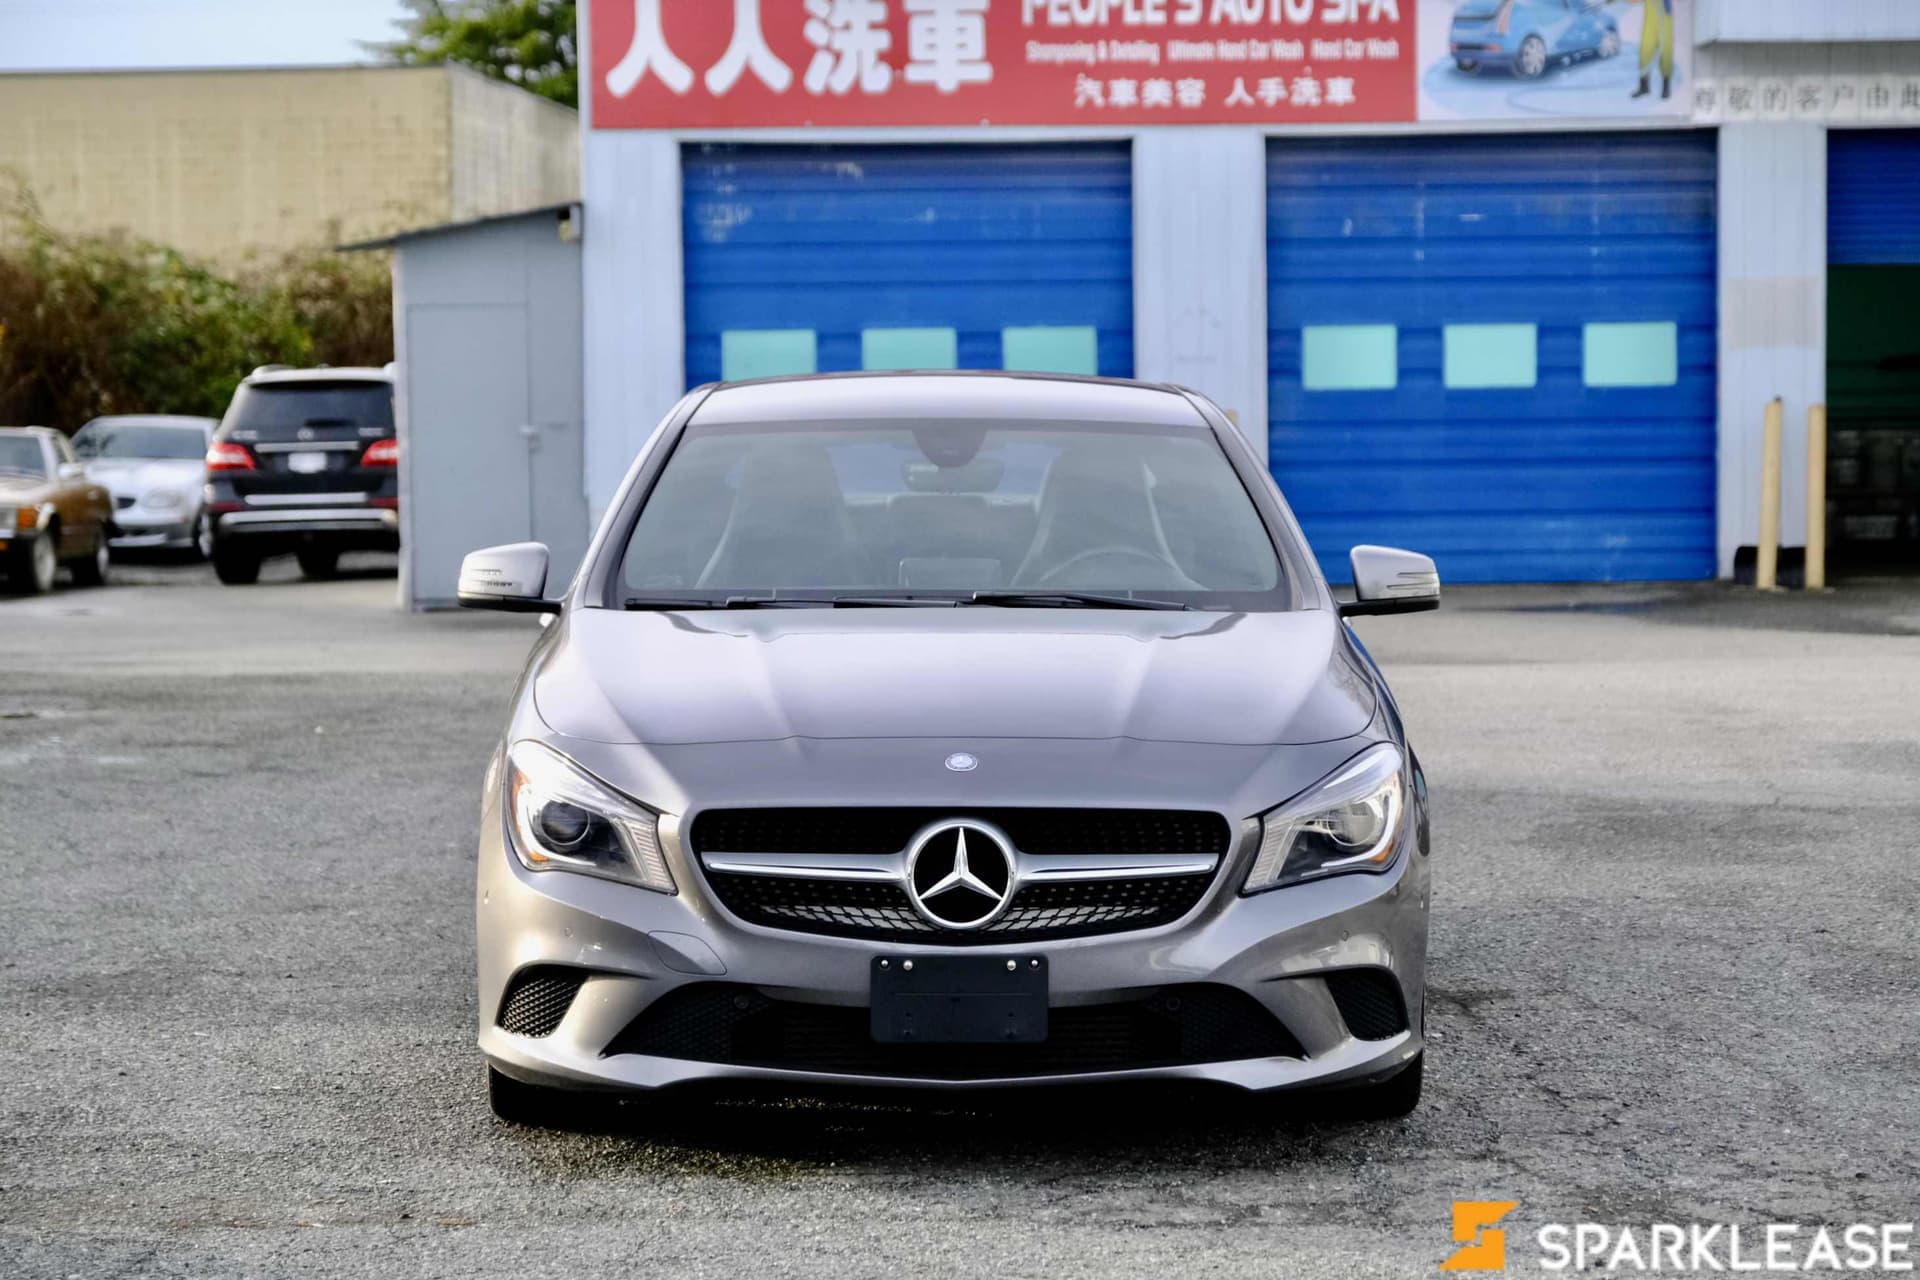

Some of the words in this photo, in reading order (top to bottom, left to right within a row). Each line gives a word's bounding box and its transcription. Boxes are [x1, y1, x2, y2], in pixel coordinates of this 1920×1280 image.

[1021, 0, 1203, 26] PEOPLES
[1209, 0, 1315, 25] AUTO
[1321, 0, 1400, 24] SPA
[605, 0, 993, 96] 人人洗車
[1217, 39, 1248, 61] Hand
[1249, 38, 1270, 61] Car
[1271, 39, 1304, 61] Wash
[1311, 38, 1342, 60] Hand
[1343, 38, 1364, 60] Car
[1366, 38, 1400, 60] Wash
[1074, 74, 1206, 108] 汽車美容
[1224, 76, 1356, 107] 人手洗車
